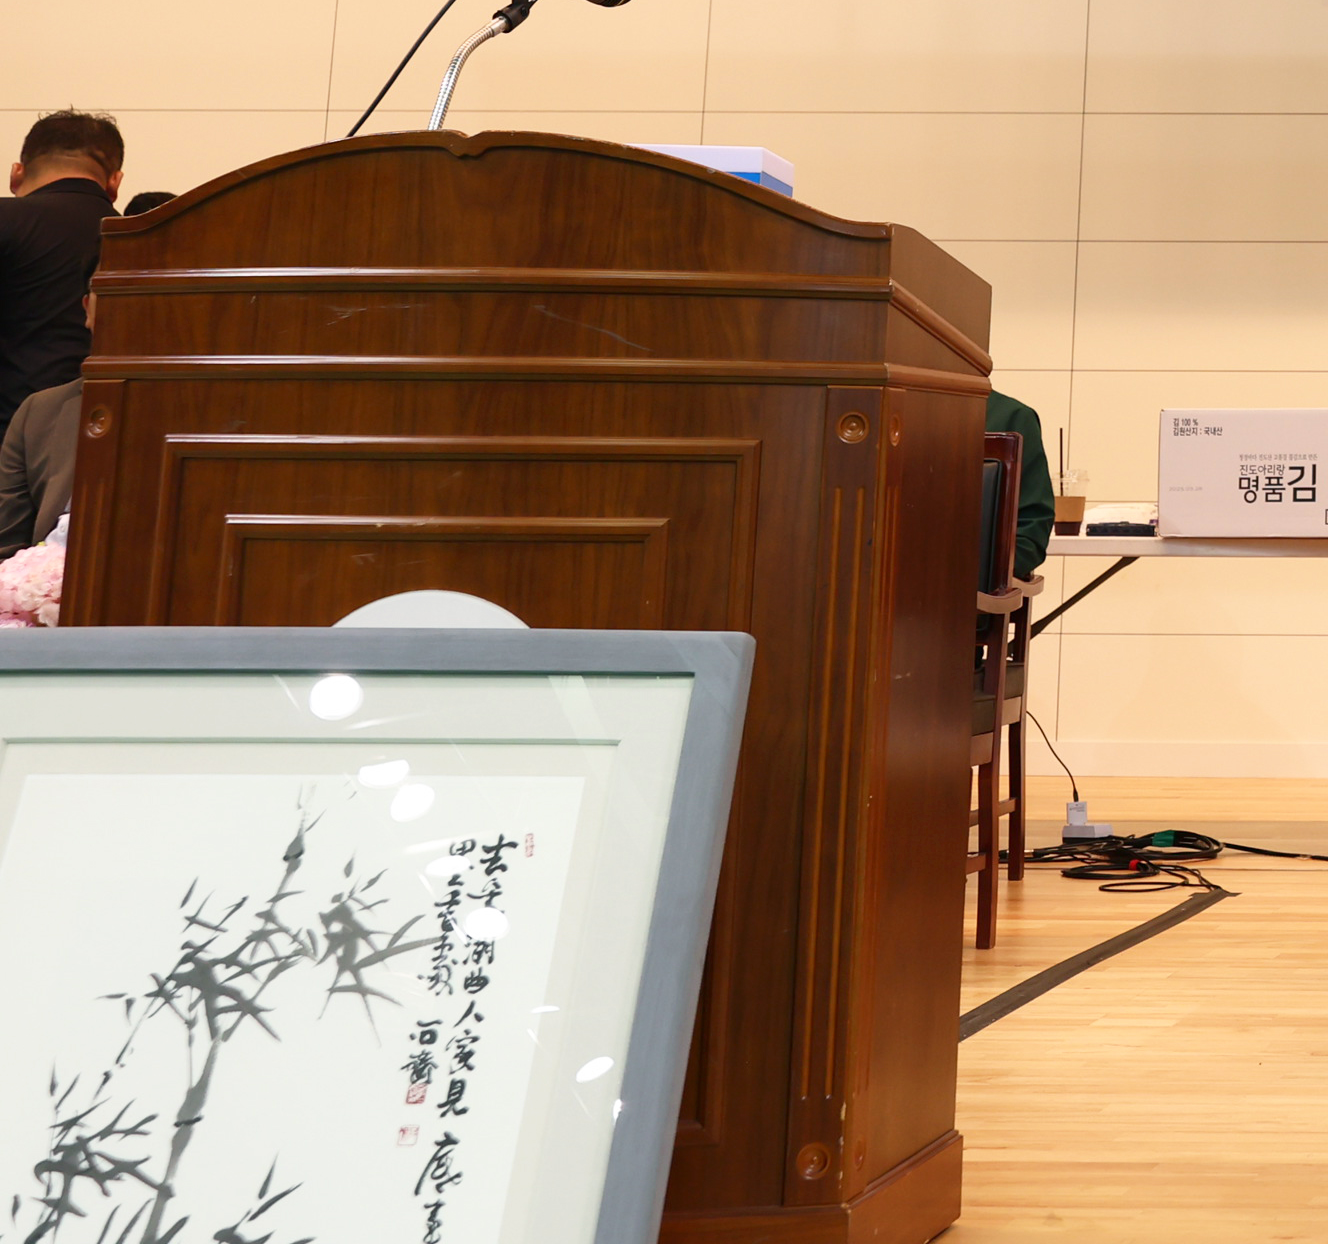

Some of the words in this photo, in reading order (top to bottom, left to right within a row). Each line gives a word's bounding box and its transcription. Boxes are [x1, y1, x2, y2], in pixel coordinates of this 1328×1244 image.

[1173, 418, 1179, 427] 김
[1181, 418, 1191, 426] 100
[1173, 427, 1198, 436] 김원산지
[1204, 427, 1223, 436] 국내산
[1239, 464, 1286, 476] 진도아리랑
